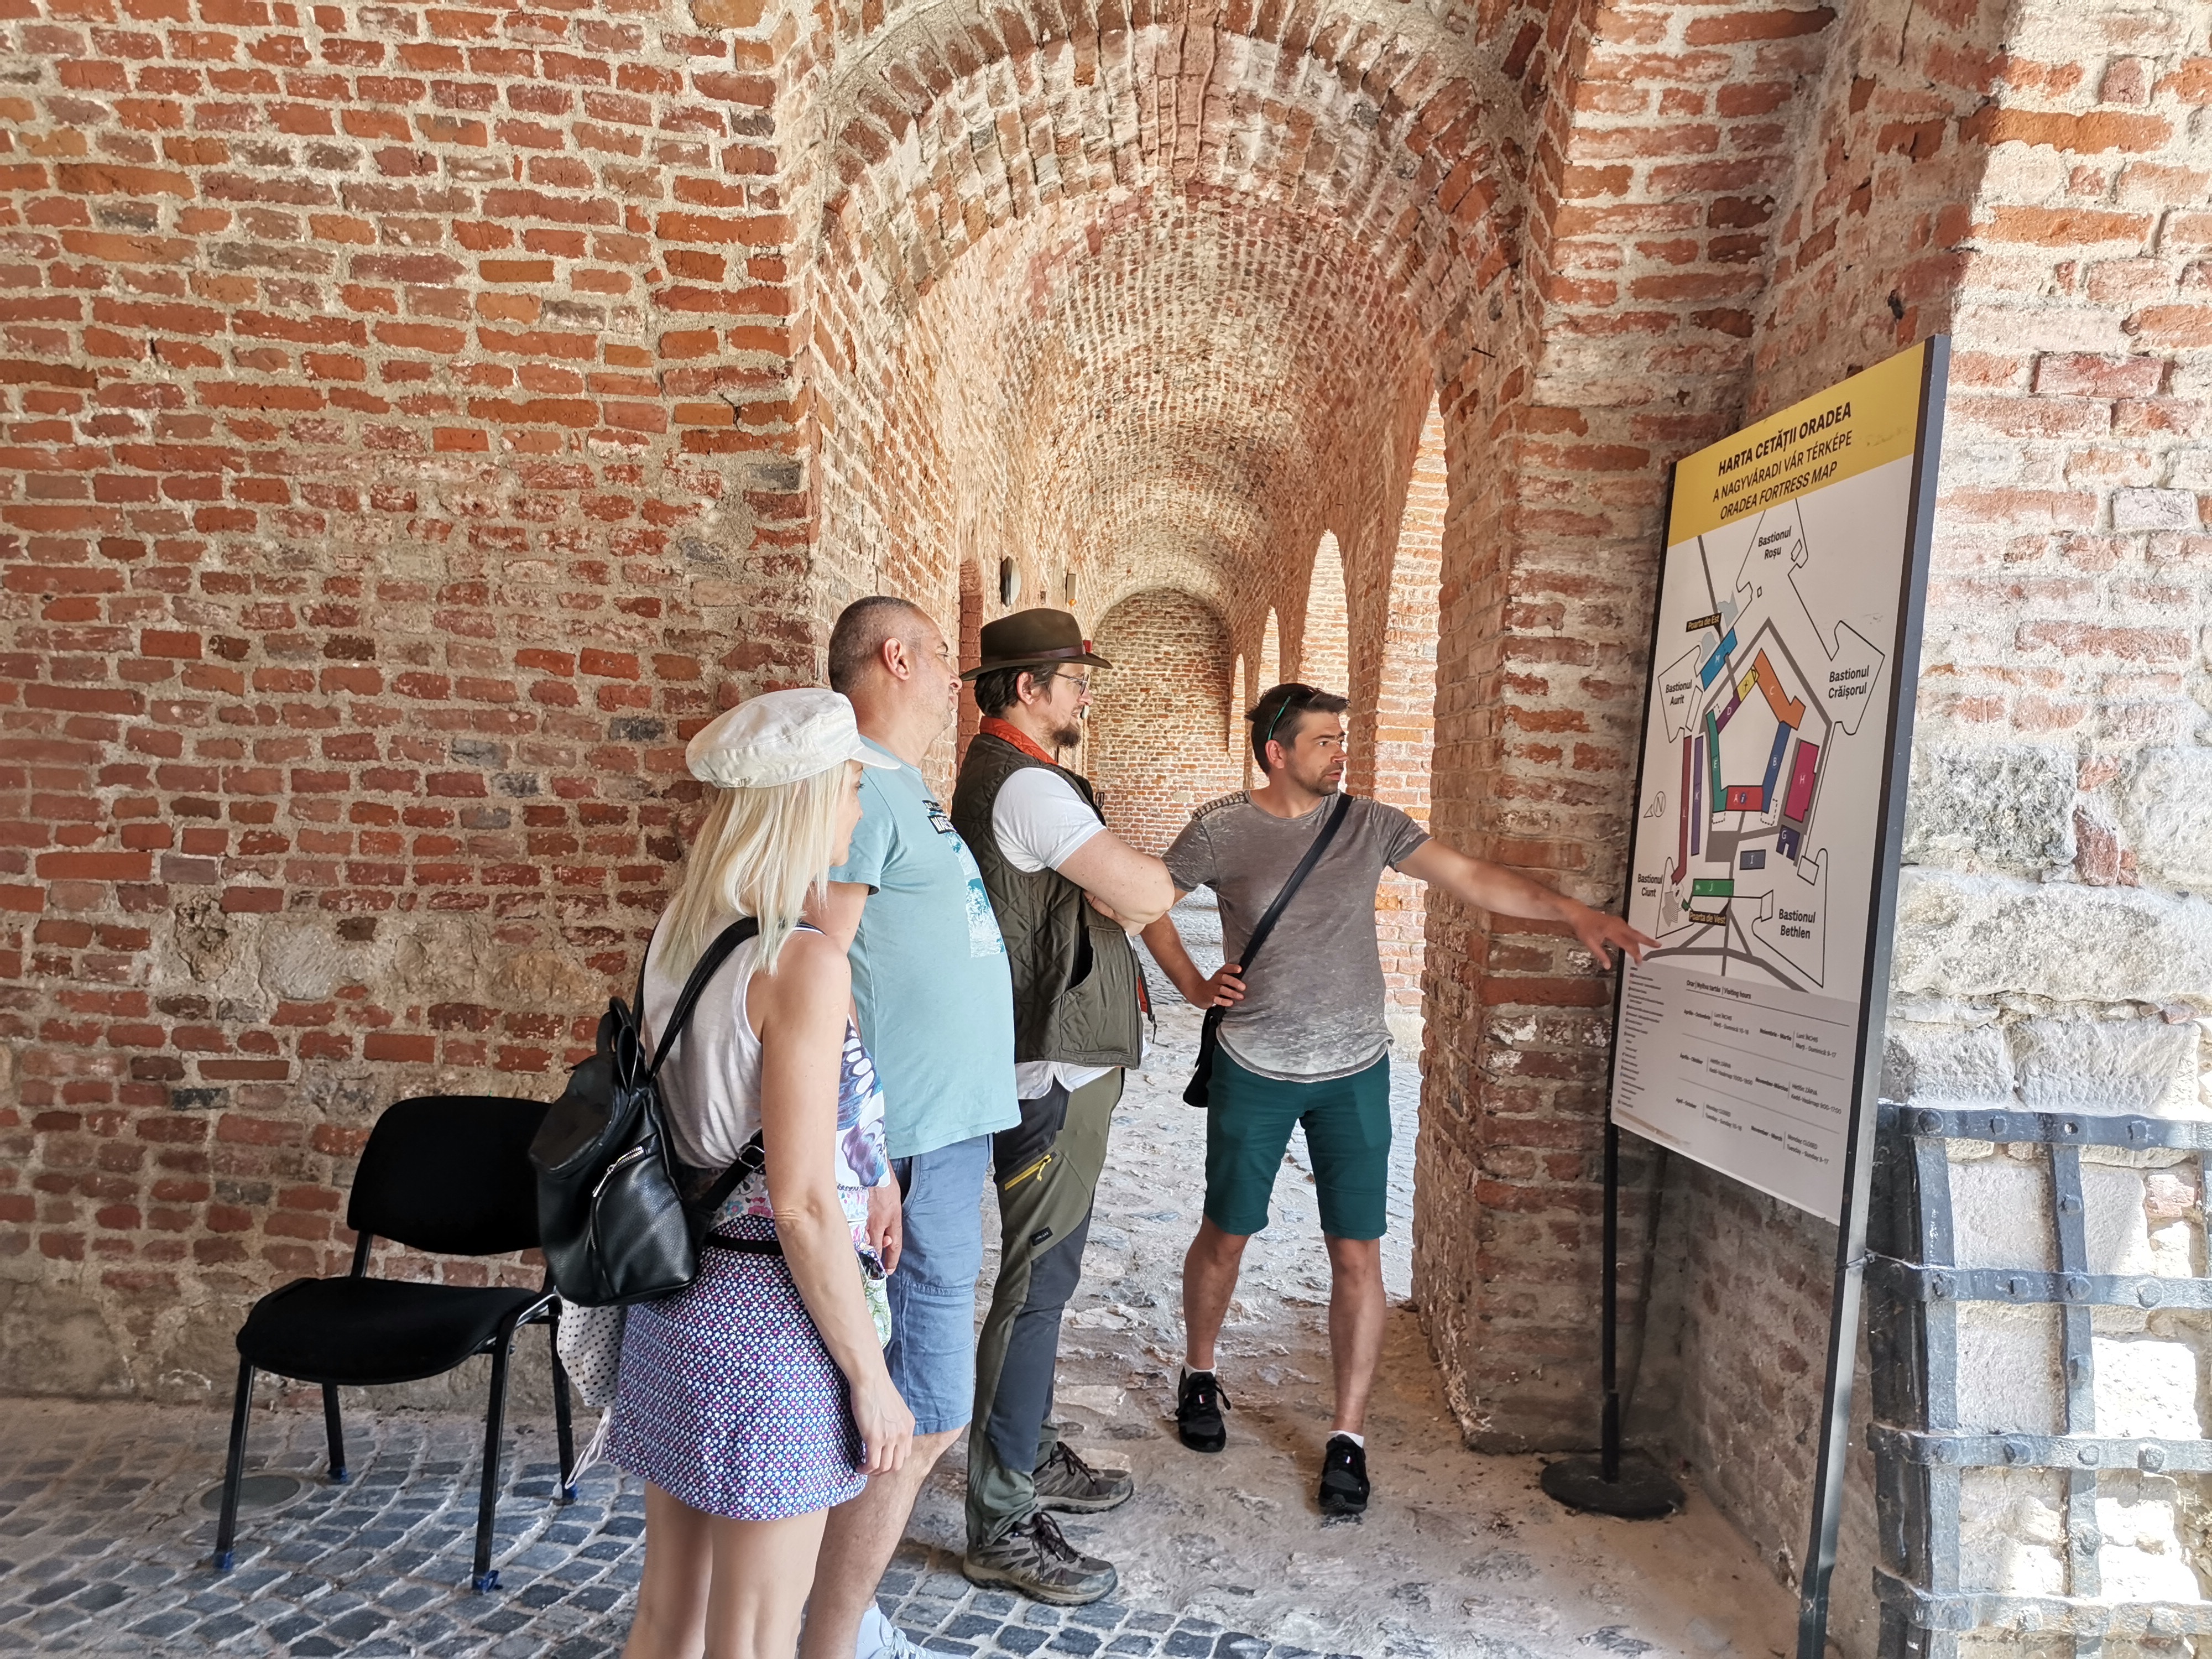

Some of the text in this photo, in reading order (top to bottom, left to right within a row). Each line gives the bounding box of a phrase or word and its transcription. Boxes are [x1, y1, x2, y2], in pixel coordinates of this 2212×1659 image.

[1718, 447, 1753, 477] HARTA
[1799, 401, 1851, 439] ORADEA
[1712, 430, 1853, 503] A NAGYVÁRADI VÁR TÉRKÉPE
[1720, 461, 1838, 520] ORADEA FORTRESS MAP
[1758, 525, 1792, 547] Bastionul
[1688, 615, 1720, 630] Poarta de Est
[1829, 665, 1869, 682] Bastionul
[1666, 679, 1692, 693] Bastionul
[1828, 682, 1867, 700] Crăișorul
[1670, 695, 1685, 706] Aurit
[1726, 707, 1732, 716] D
[1799, 775, 1806, 784] H
[1781, 830, 1787, 839] G
[1637, 874, 1663, 884] Bastionul
[1641, 887, 1656, 897] Ciunt
[1689, 912, 1705, 922] Poarta
[1714, 915, 1726, 924] Vest
[1778, 909, 1816, 924] Bastionul
[1780, 925, 1810, 939] Bethlen
